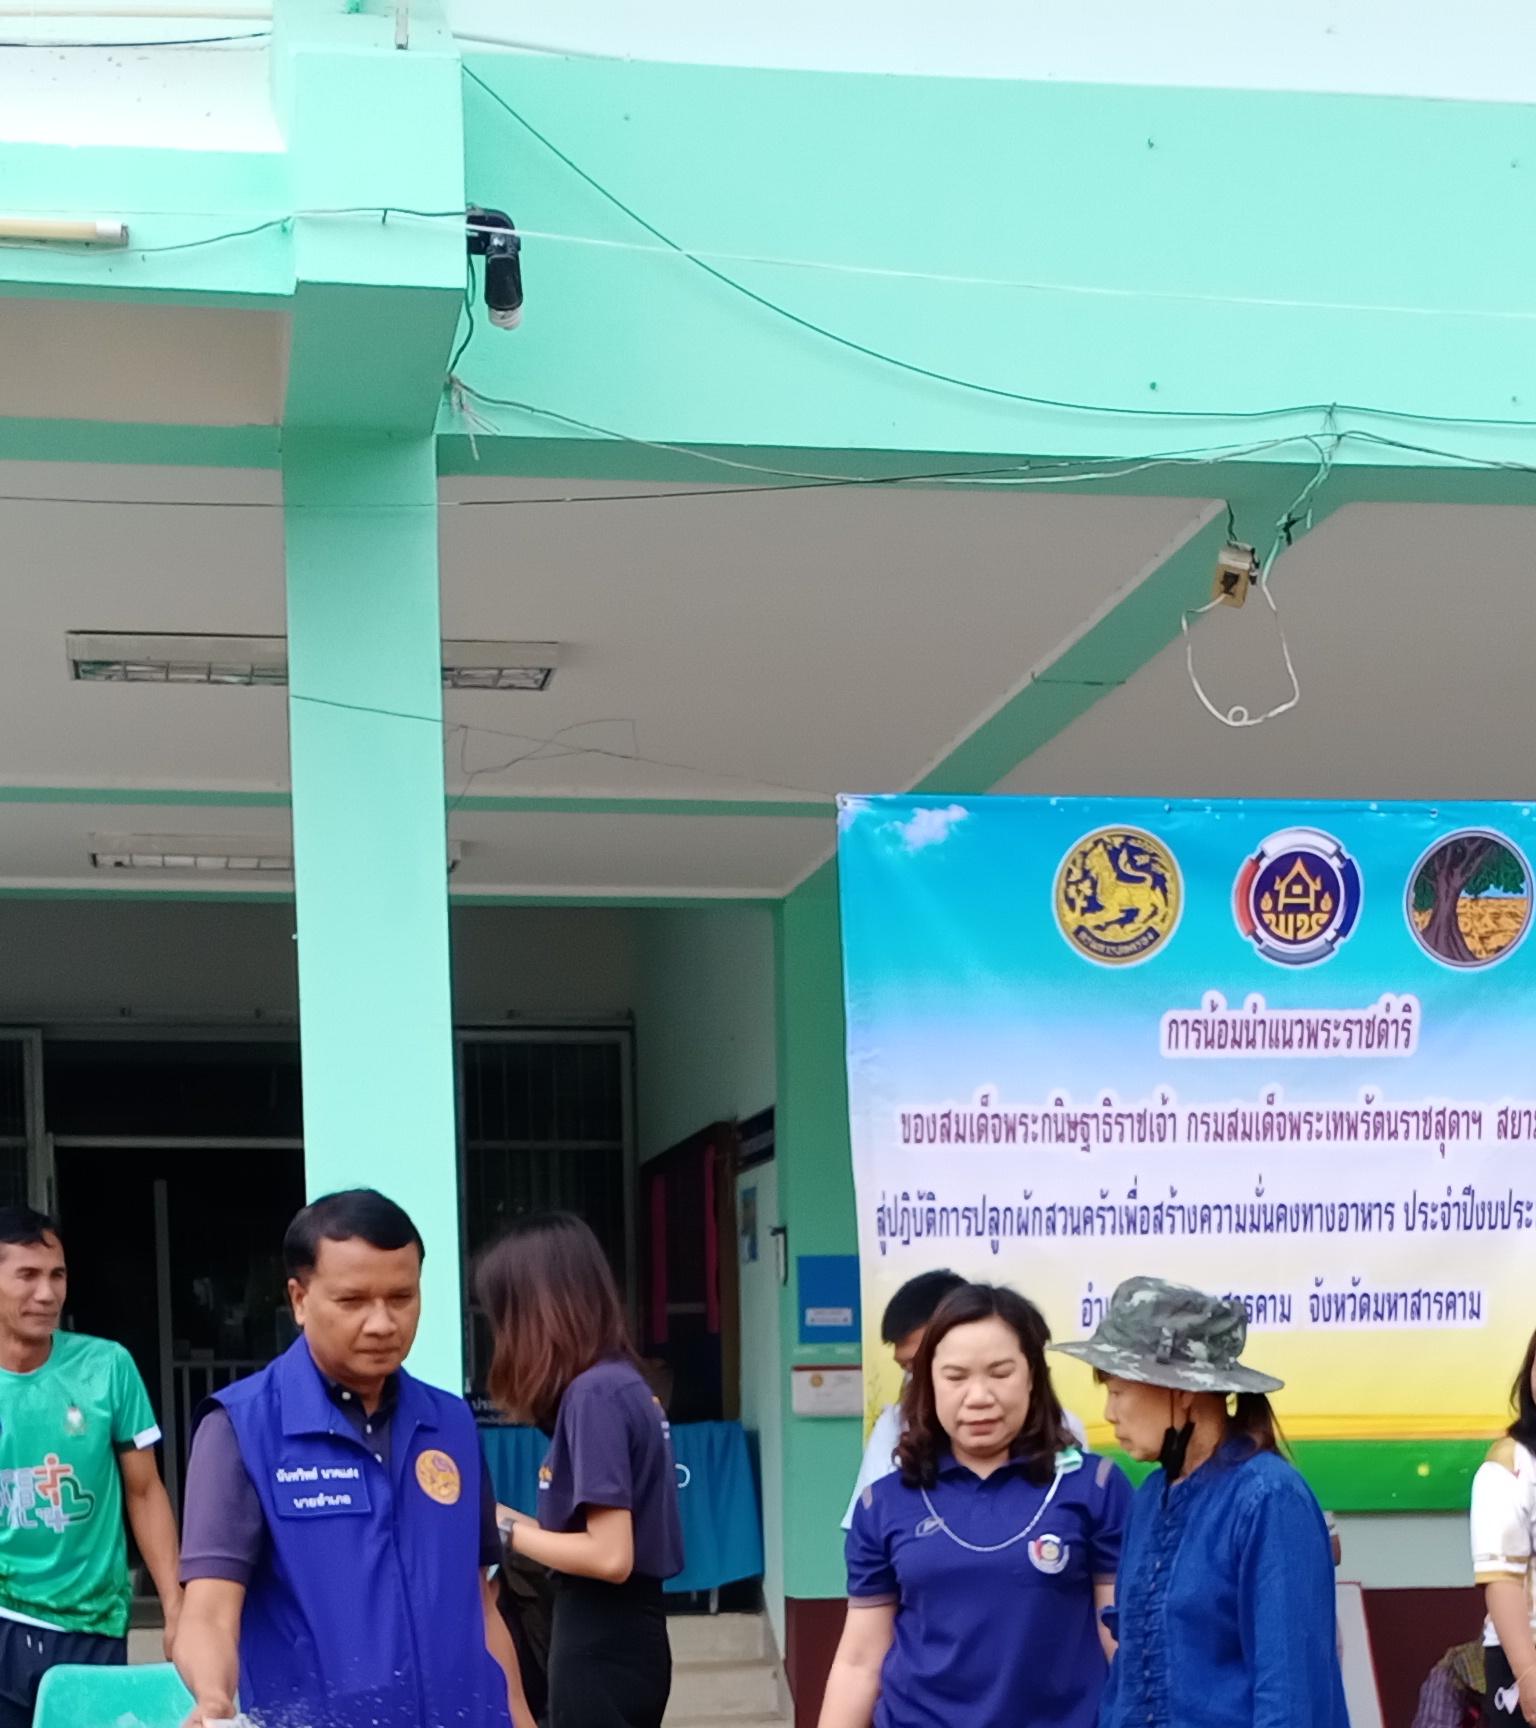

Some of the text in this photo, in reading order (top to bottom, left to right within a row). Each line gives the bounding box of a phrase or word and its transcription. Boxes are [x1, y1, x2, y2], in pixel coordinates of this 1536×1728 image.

[1167, 999, 1413, 1050] การน้อมนำแนวพระราชดำริ
[900, 1092, 1178, 1153] ของสมเด็จพระกนิษฐาธิราชเจ้า
[1186, 1092, 1483, 1158] กรมสมเด็จพระเทพรัตนราชสุดาฯ
[1308, 1276, 1482, 1323] จังหวัดมหาสารคาม
